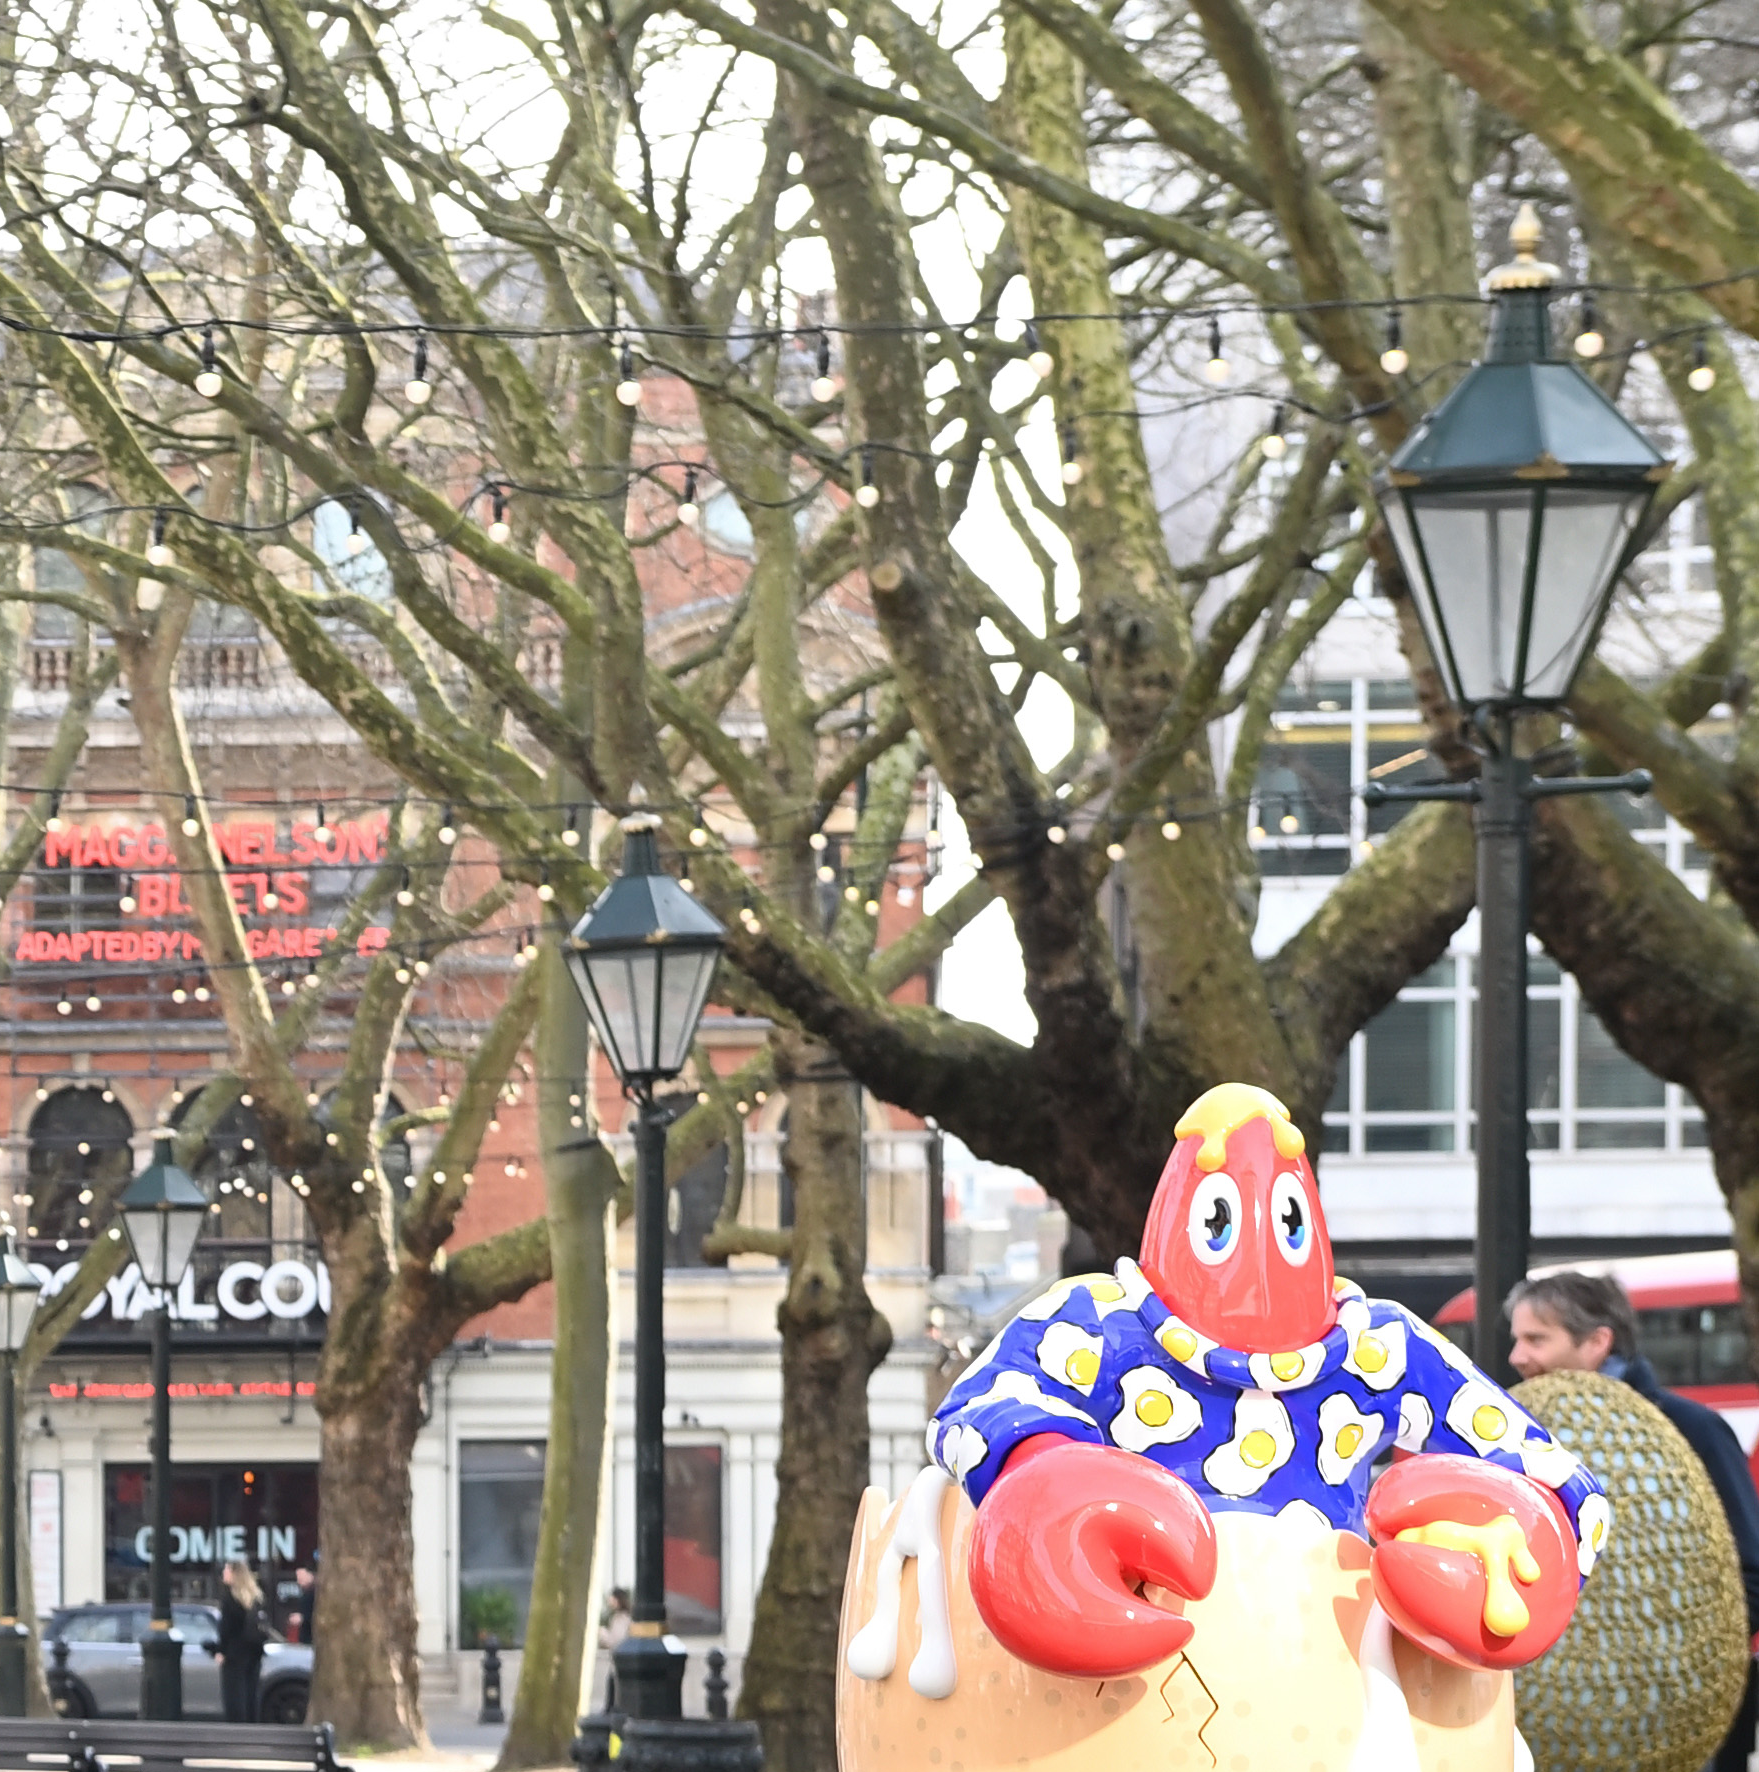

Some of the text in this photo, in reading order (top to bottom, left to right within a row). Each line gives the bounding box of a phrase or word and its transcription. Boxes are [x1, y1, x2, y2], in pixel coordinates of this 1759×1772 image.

[45, 823, 178, 868] MAGG
[137, 872, 310, 917] BLETS
[257, 1525, 296, 1562] IN
